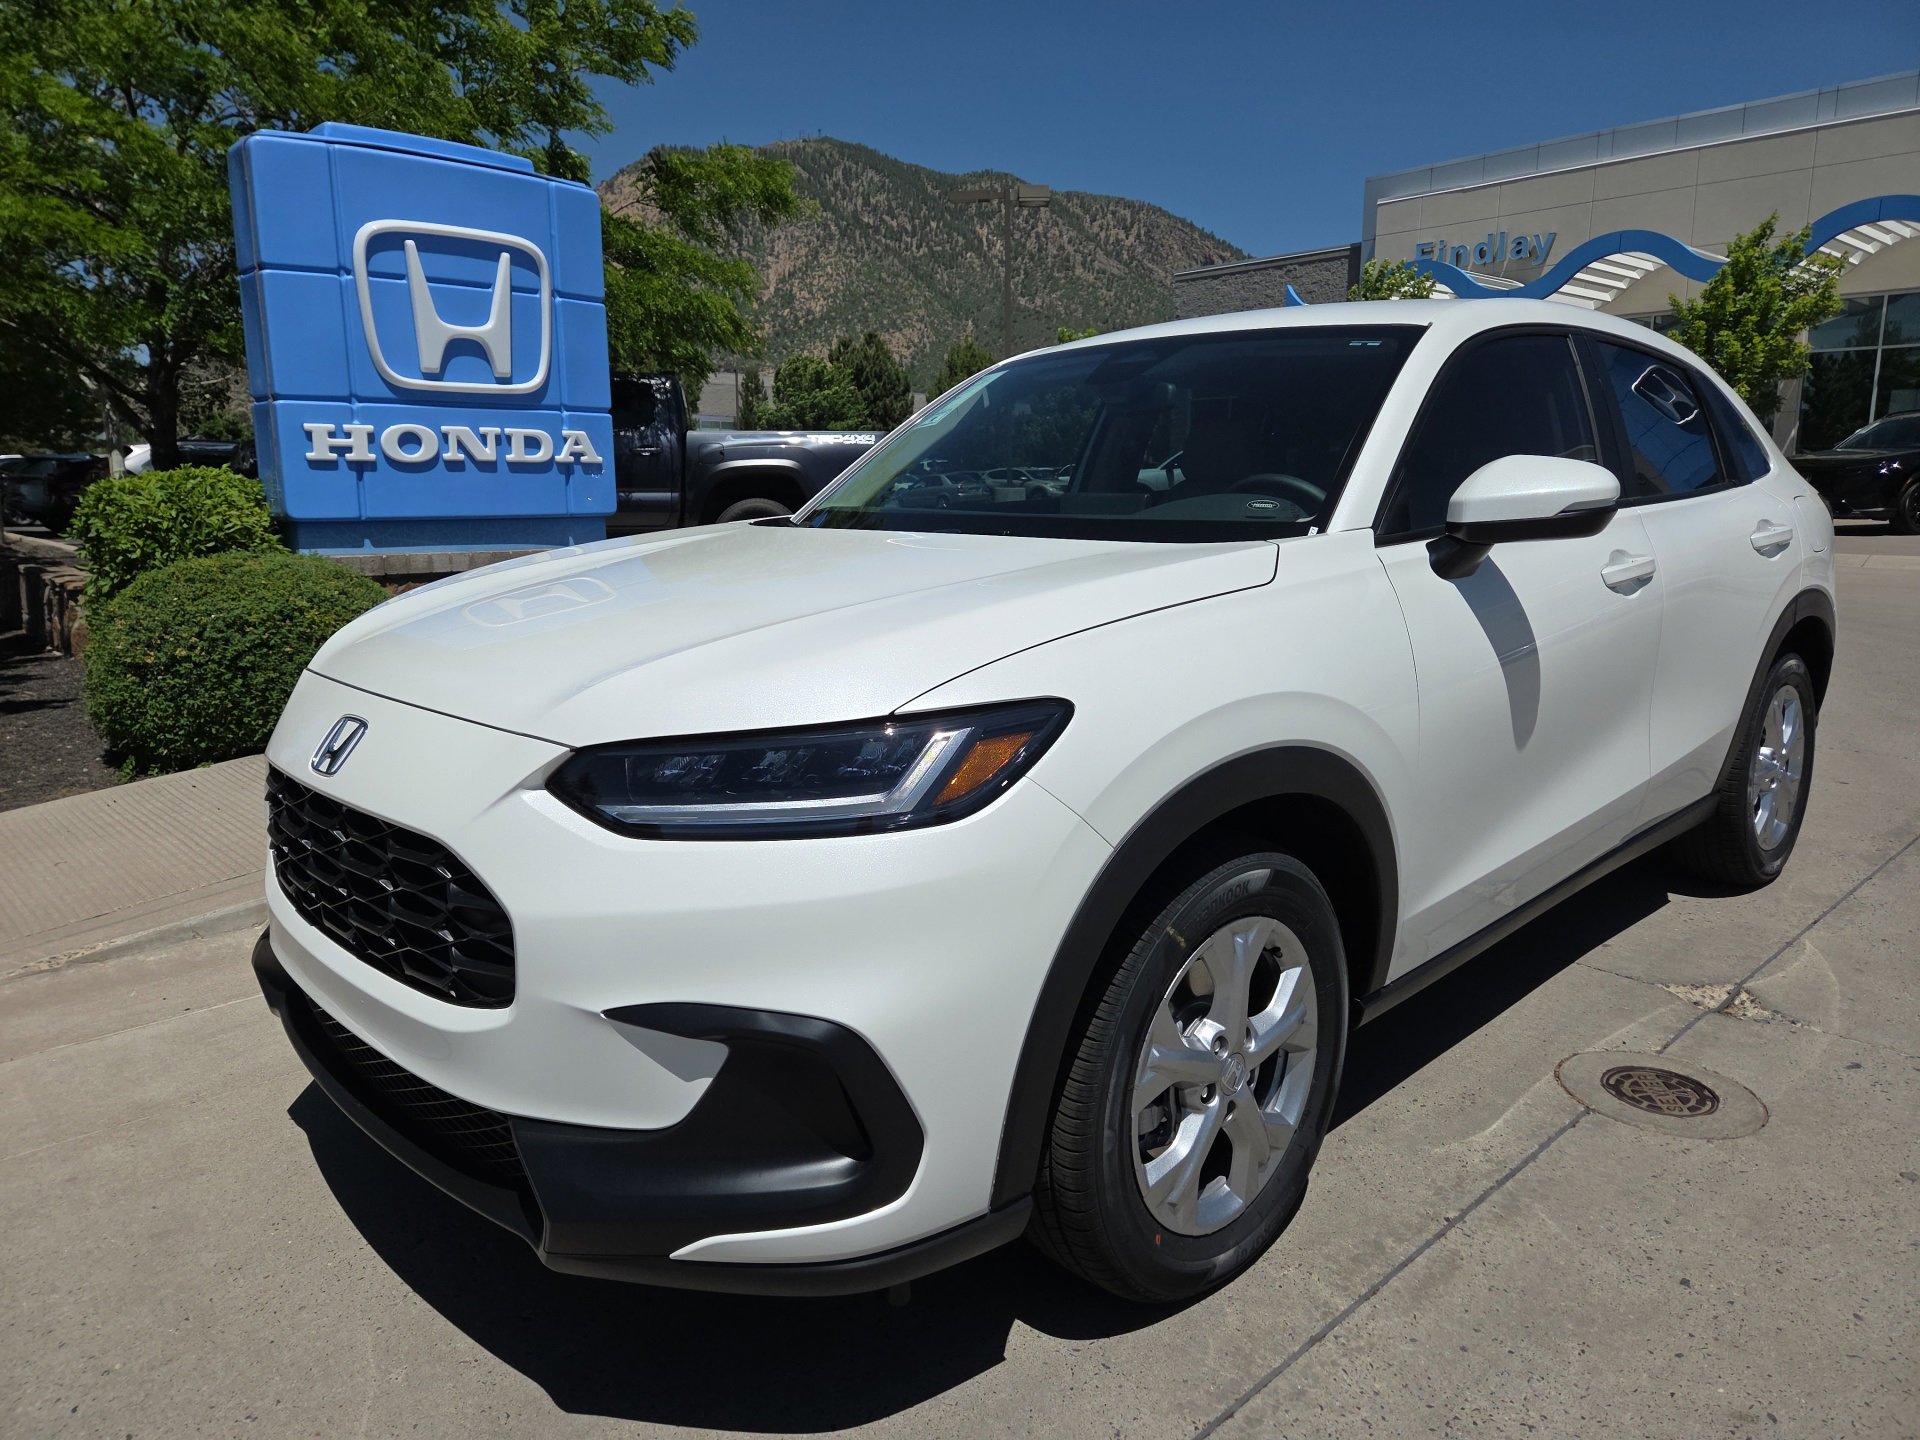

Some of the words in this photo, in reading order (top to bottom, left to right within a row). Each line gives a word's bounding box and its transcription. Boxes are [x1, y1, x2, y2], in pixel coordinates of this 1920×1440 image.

[1415, 231, 1557, 267] Findlay
[303, 422, 603, 464] HONDA
[1637, 1073, 1685, 1113] SEWER
